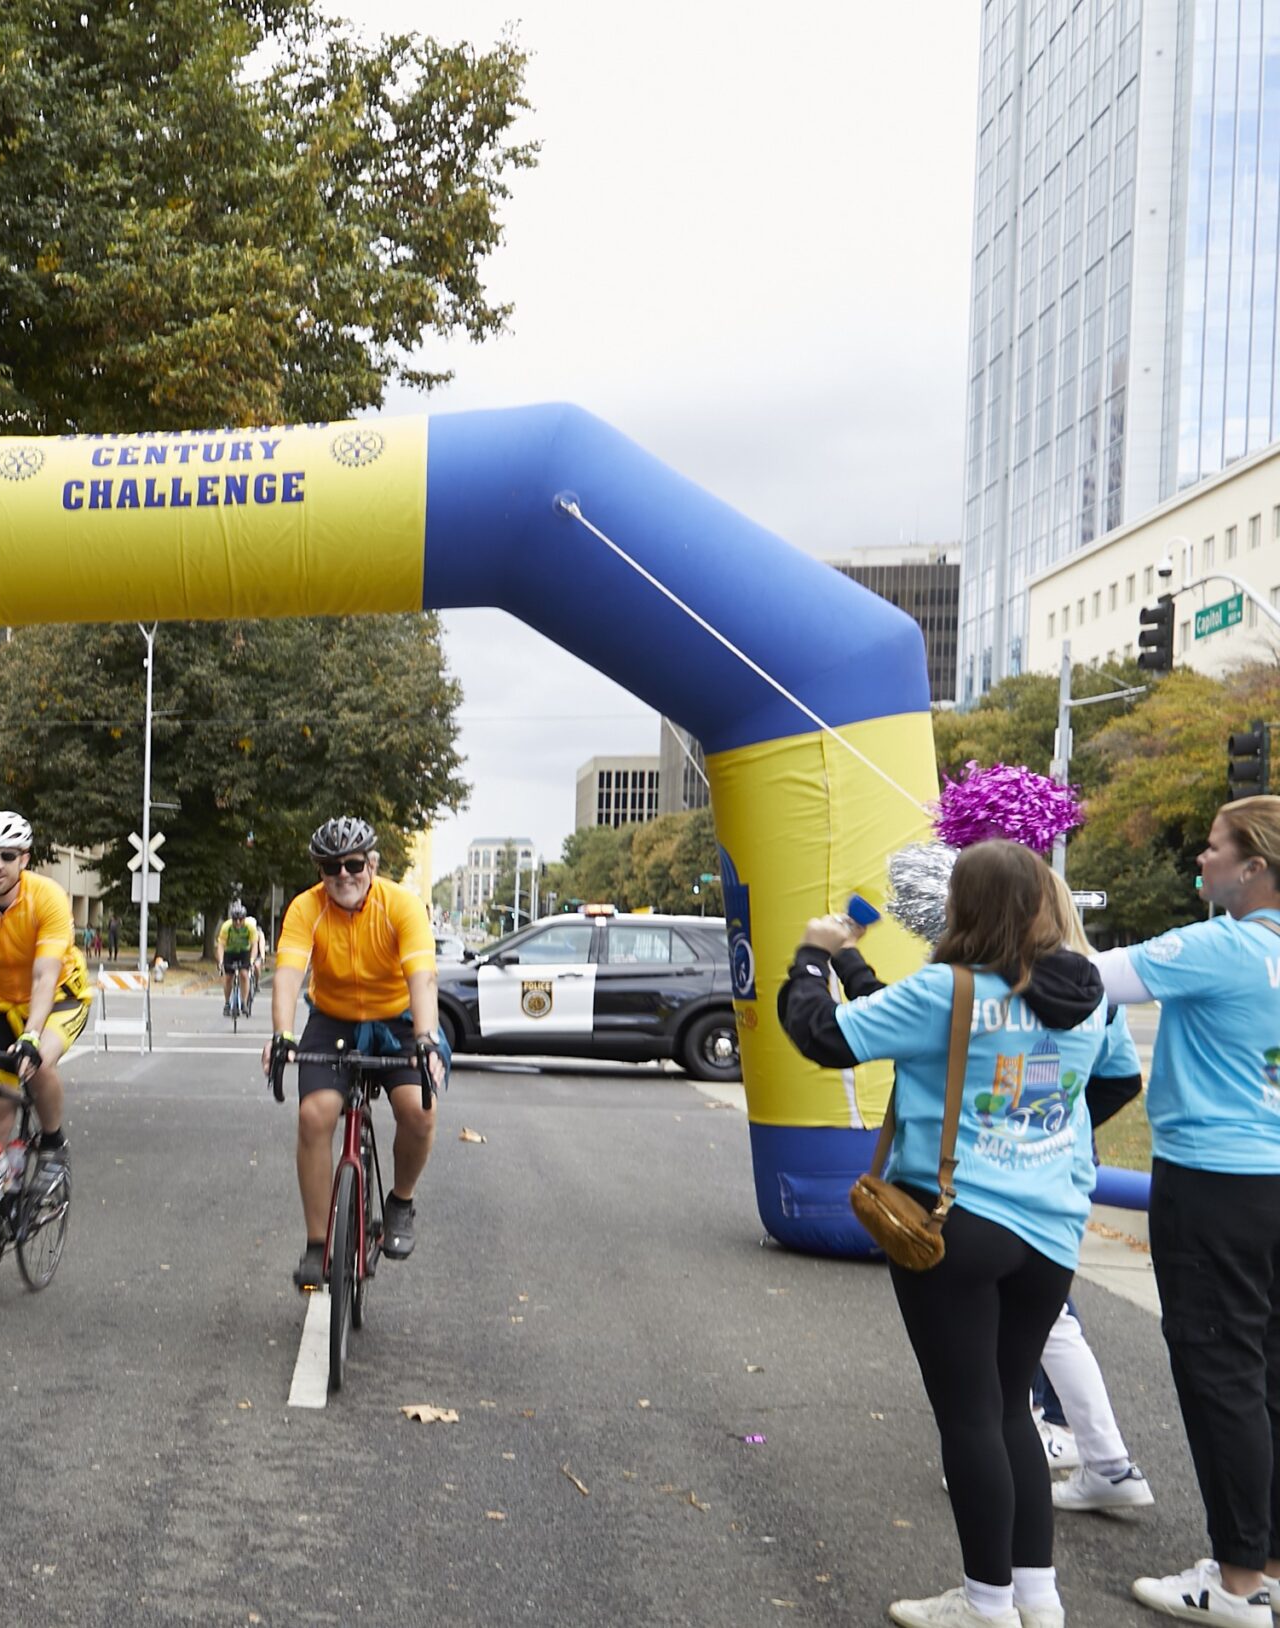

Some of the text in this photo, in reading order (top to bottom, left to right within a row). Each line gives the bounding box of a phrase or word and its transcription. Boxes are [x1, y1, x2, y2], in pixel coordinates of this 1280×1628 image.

[91, 439, 282, 467] CENTURY
[62, 471, 306, 511] CHALLENGE
[1196, 606, 1222, 635] Capitol
[524, 982, 552, 991] POLICE
